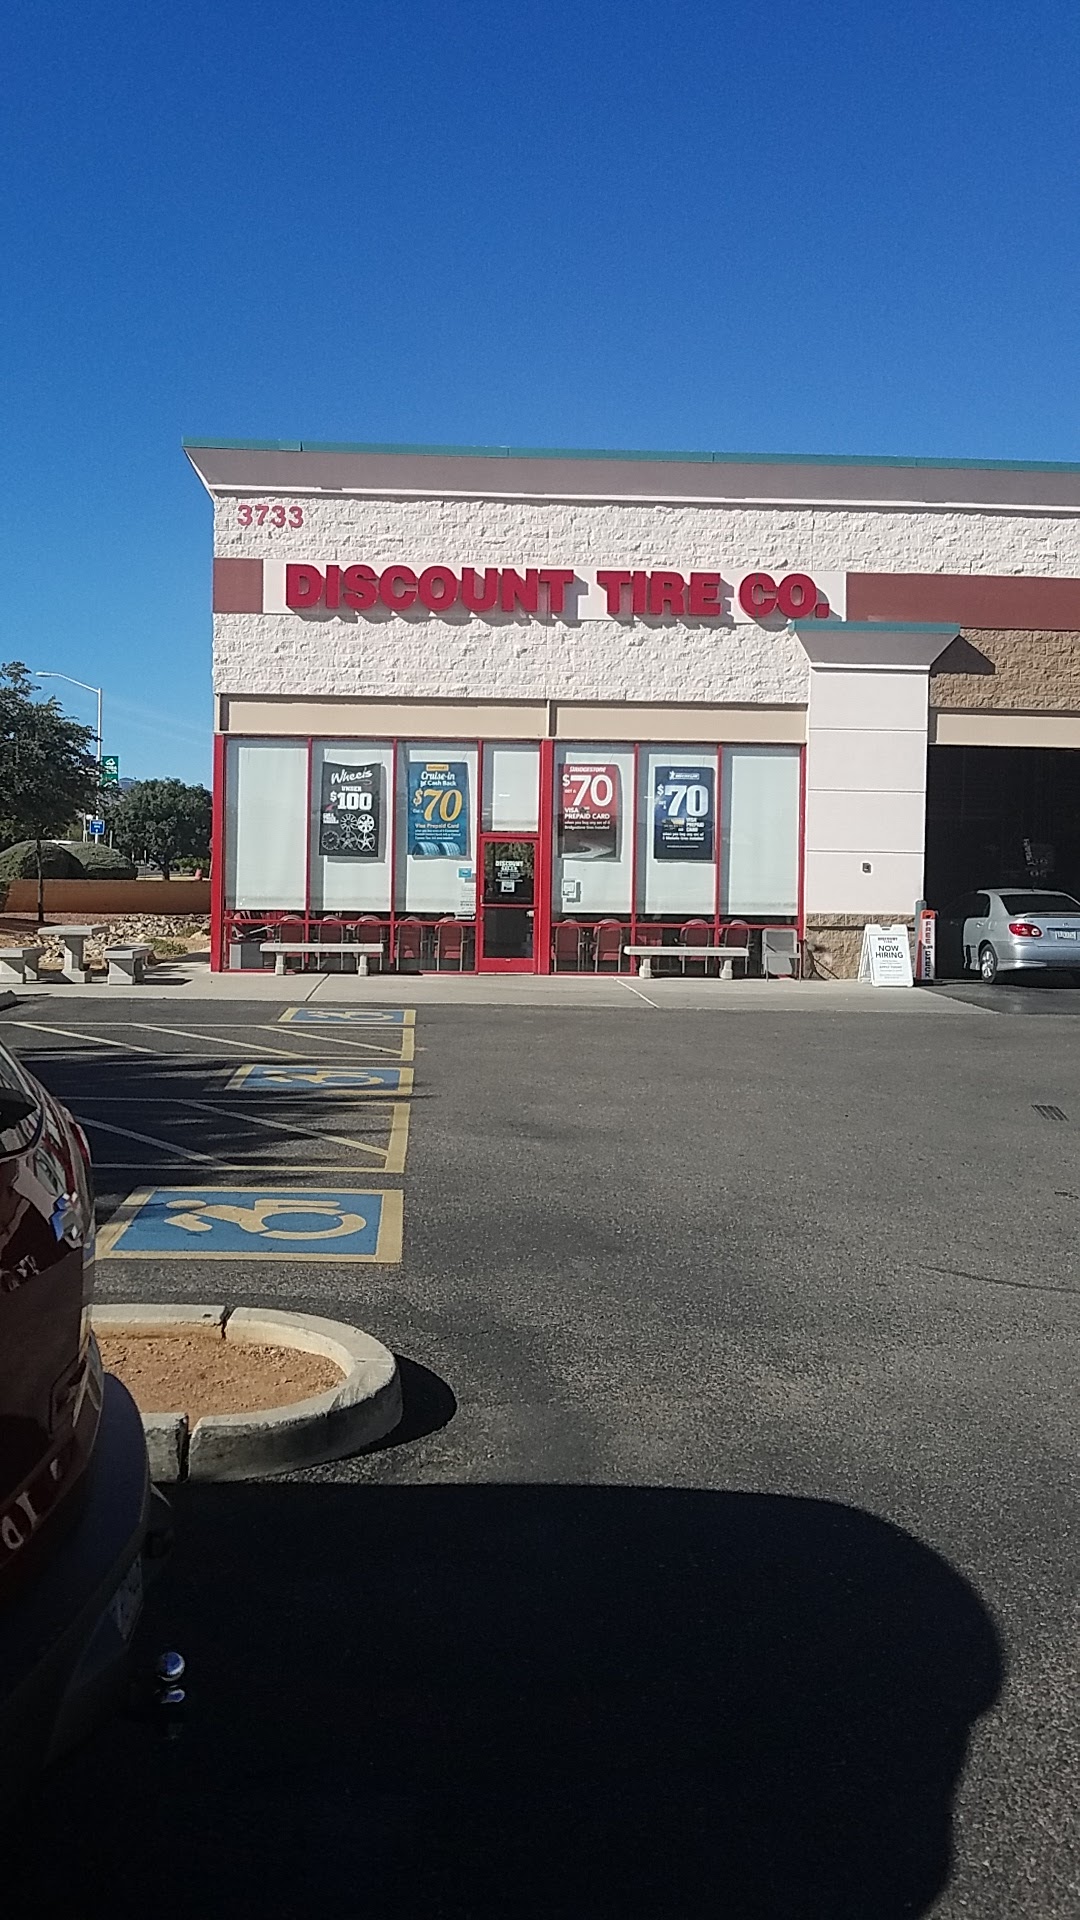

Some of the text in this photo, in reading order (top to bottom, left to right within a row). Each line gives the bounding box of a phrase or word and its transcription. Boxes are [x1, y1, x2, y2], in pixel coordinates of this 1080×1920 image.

[237, 504, 304, 528] 3733
[285, 563, 830, 619] DISCOUNT TIRE CO.
[331, 767, 373, 785] Wheels
[421, 771, 455, 781] Cruise-in
[330, 791, 372, 811] $100
[562, 774, 613, 807] $70
[657, 784, 709, 817] $70
[413, 788, 463, 822] $70
[875, 951, 904, 959] HIRING
